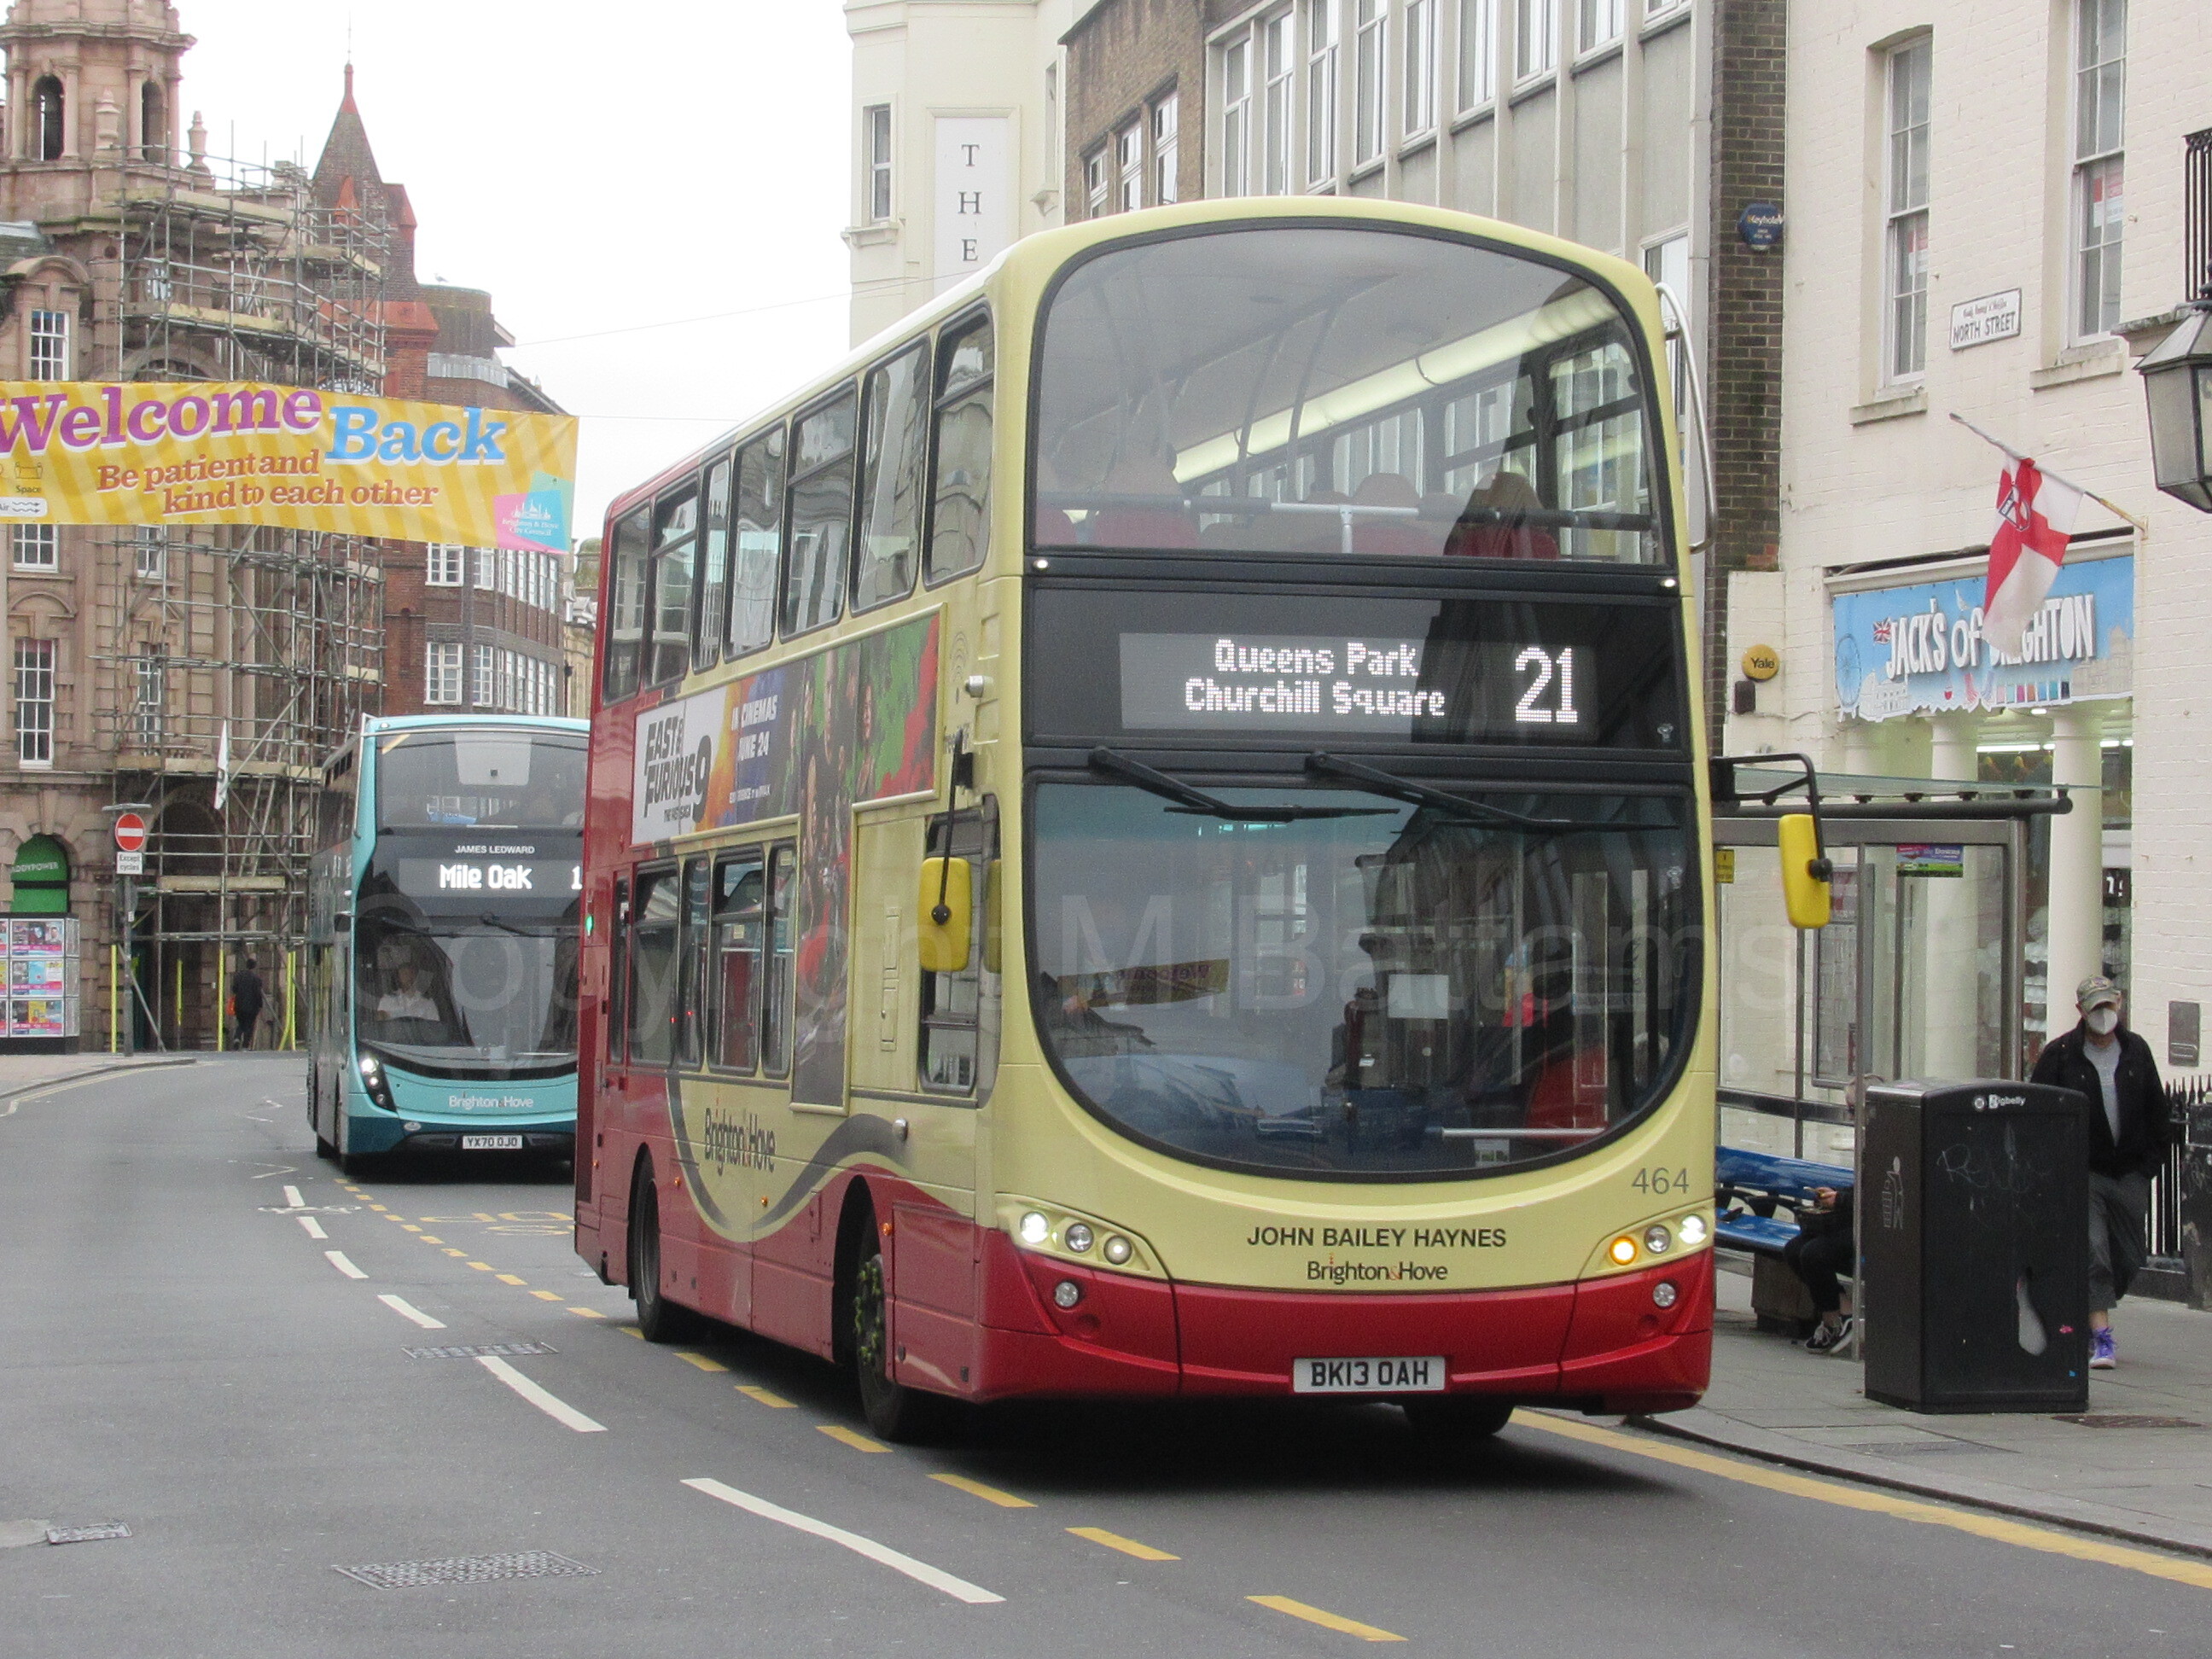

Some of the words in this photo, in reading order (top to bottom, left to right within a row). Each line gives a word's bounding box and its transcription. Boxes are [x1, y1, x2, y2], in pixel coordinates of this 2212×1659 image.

[958, 143, 982, 262] THE
[1953, 320, 1981, 343] NORTH
[1985, 311, 2016, 336] STREET
[0, 387, 323, 456] Welcome
[324, 405, 506, 463] Back
[98, 465, 139, 492] Be
[143, 452, 256, 492] patient
[259, 449, 320, 475] and
[16, 484, 42, 494] Space
[164, 481, 236, 515] kind
[241, 482, 265, 505] to
[270, 479, 346, 505] each
[352, 479, 439, 506] other
[1886, 598, 1947, 680] JACK'S
[1989, 594, 2094, 667] GHTON
[1214, 638, 1335, 675] Queens
[1347, 642, 1419, 676] Park
[1750, 657, 1775, 669] Yale
[1185, 678, 1320, 714] Churchill
[1332, 681, 1447, 718] Square
[1514, 646, 1578, 724] 21
[741, 695, 778, 728] CINEMAS
[757, 731, 771, 756] 24
[644, 753, 696, 818] FURIOUS
[692, 735, 712, 824] 9
[119, 854, 141, 864] Except
[455, 845, 487, 854] JAMES
[489, 845, 535, 854] LEDWARD
[119, 862, 140, 872] cycles
[439, 864, 482, 889] Mile
[487, 864, 533, 890] Oak
[467, 1137, 495, 1147] YX70
[1631, 1167, 1690, 1195] 464
[1247, 1226, 1314, 1247] JOHN
[1323, 1227, 1406, 1248] BAILEY
[1413, 1228, 1507, 1248] HAYNES
[1310, 1360, 1370, 1387] BK13
[1377, 1360, 1429, 1386] OAH
